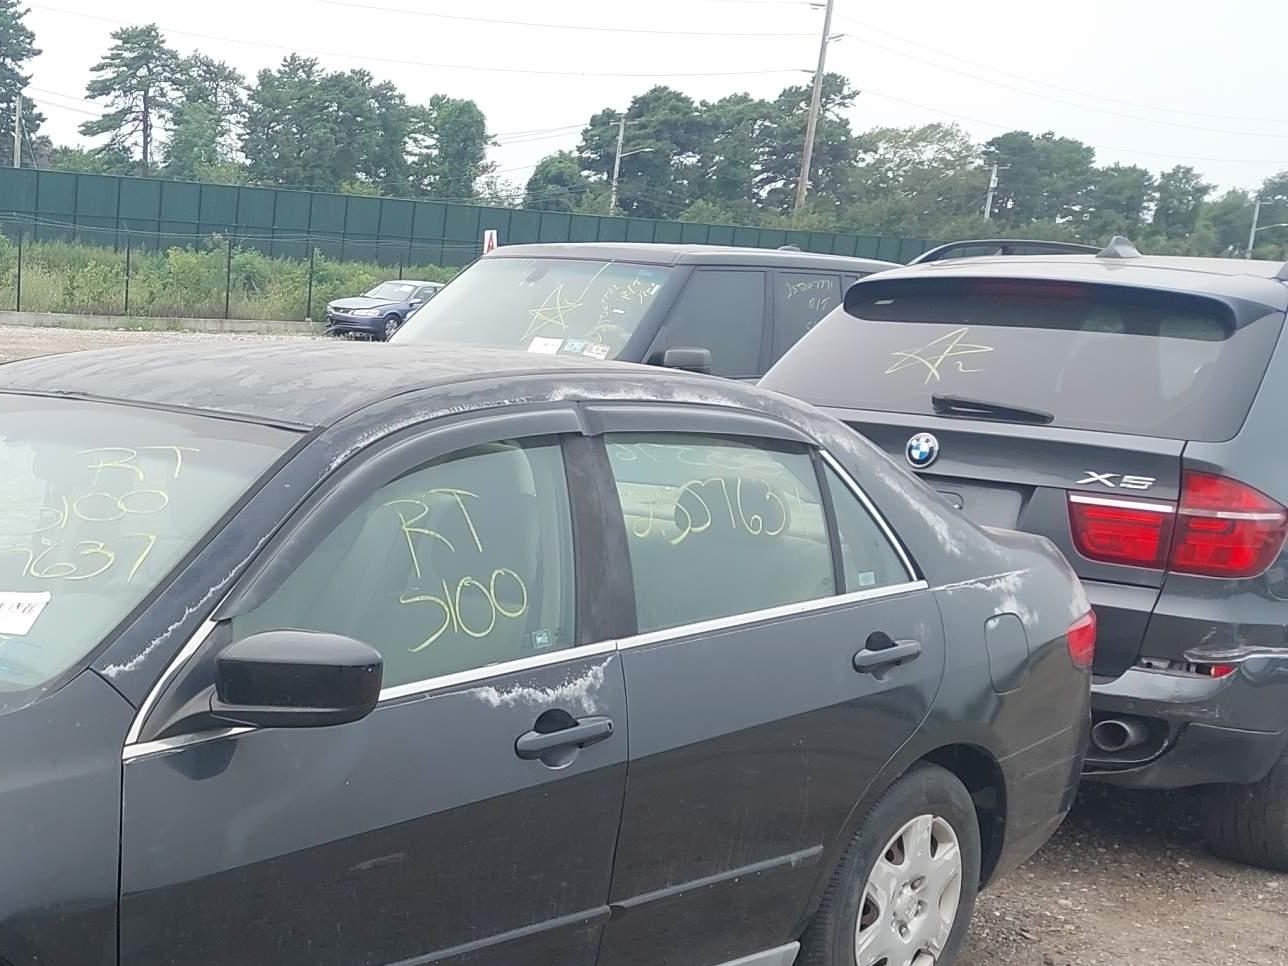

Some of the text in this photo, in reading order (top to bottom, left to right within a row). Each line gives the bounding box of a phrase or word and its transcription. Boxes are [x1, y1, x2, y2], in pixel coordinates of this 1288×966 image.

[74, 446, 199, 485] RT
[1076, 471, 1156, 489] X5
[385, 488, 482, 578] RT
[400, 568, 527, 652] 5100
